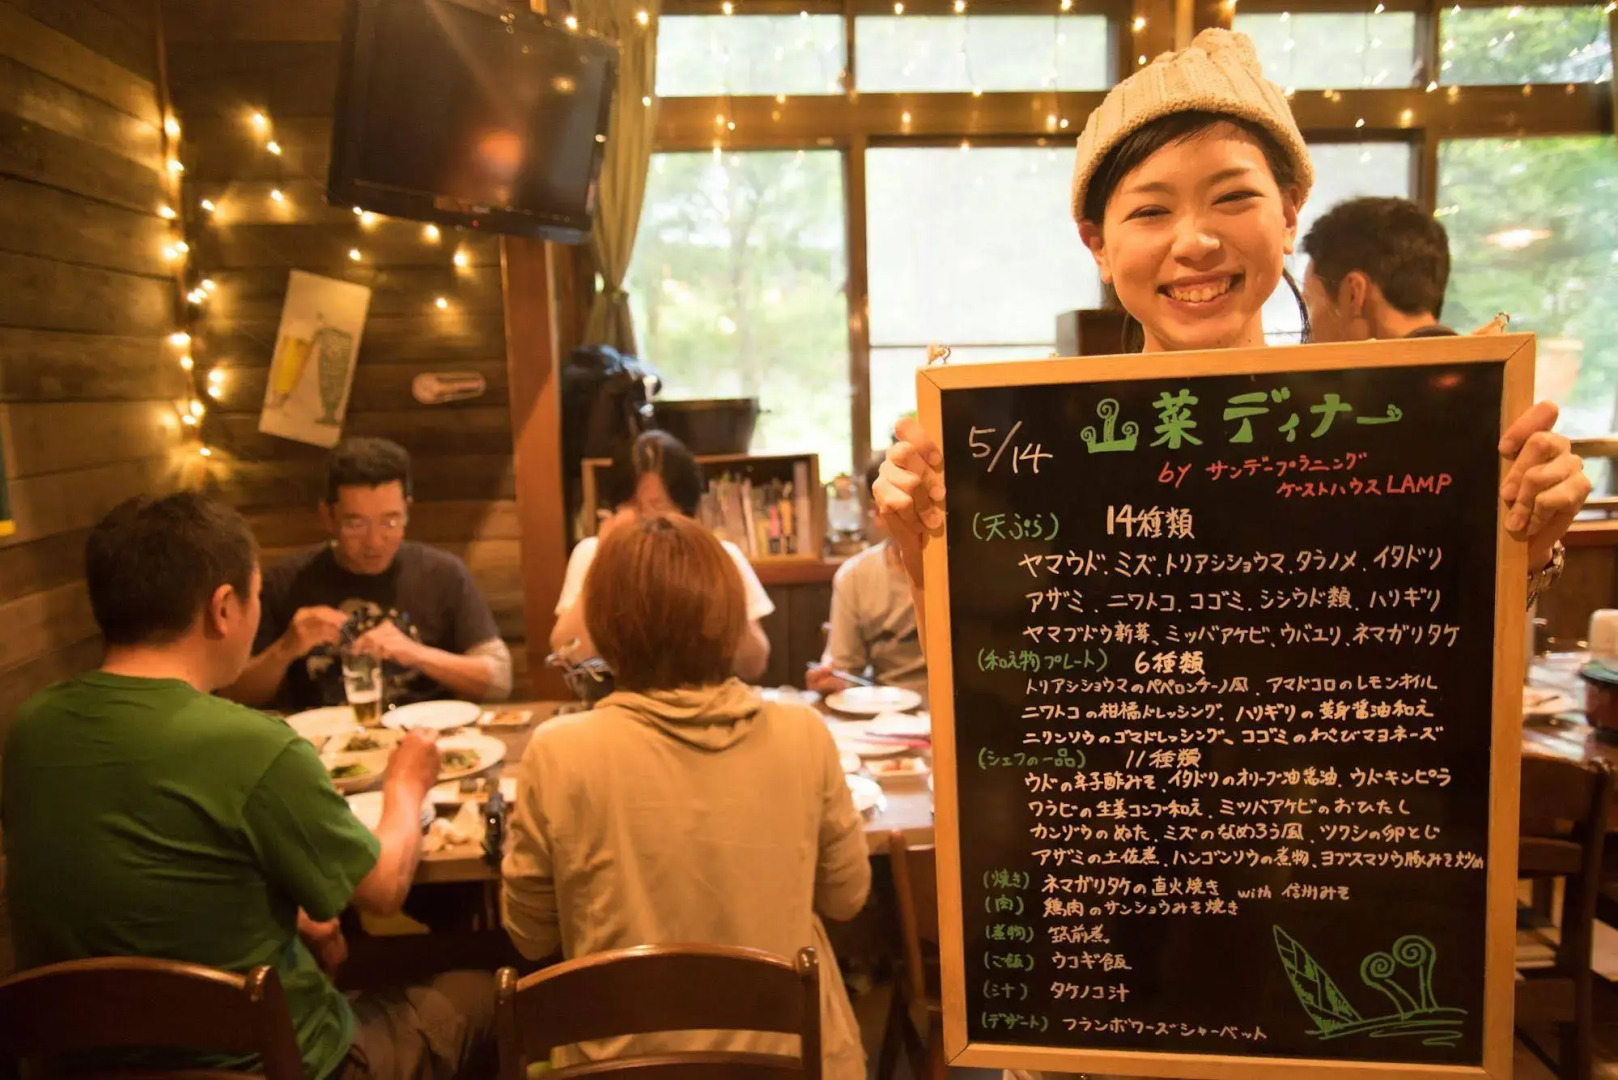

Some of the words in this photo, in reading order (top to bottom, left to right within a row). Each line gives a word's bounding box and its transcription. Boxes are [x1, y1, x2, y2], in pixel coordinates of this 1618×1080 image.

[1080, 389, 1203, 453] 山菜
[1223, 387, 1402, 442] ディナー
[969, 421, 1053, 474] 5/14
[973, 512, 1058, 541] (天ぷら)
[1107, 504, 1195, 539] 14種類
[1135, 650, 1205, 677] 6種類
[979, 747, 1085, 770] (シェフの一品)
[1126, 748, 1201, 769] 11種類
[983, 869, 1029, 889] (焼き)
[1041, 874, 1219, 896] ネマガリタケの直火焼き
[1238, 885, 1272, 899] with
[1281, 882, 1349, 900] 信州みそ
[985, 894, 1023, 915] (肉)
[986, 924, 1033, 942] (煮物)
[985, 952, 1034, 971] (ご飯)
[1052, 951, 1132, 971] ウコギ飯
[1050, 981, 1129, 1002] タケノコ汁
[983, 1013, 1047, 1031] (デザート)
[1063, 1017, 1267, 1040] フランボワーズシャーベット
